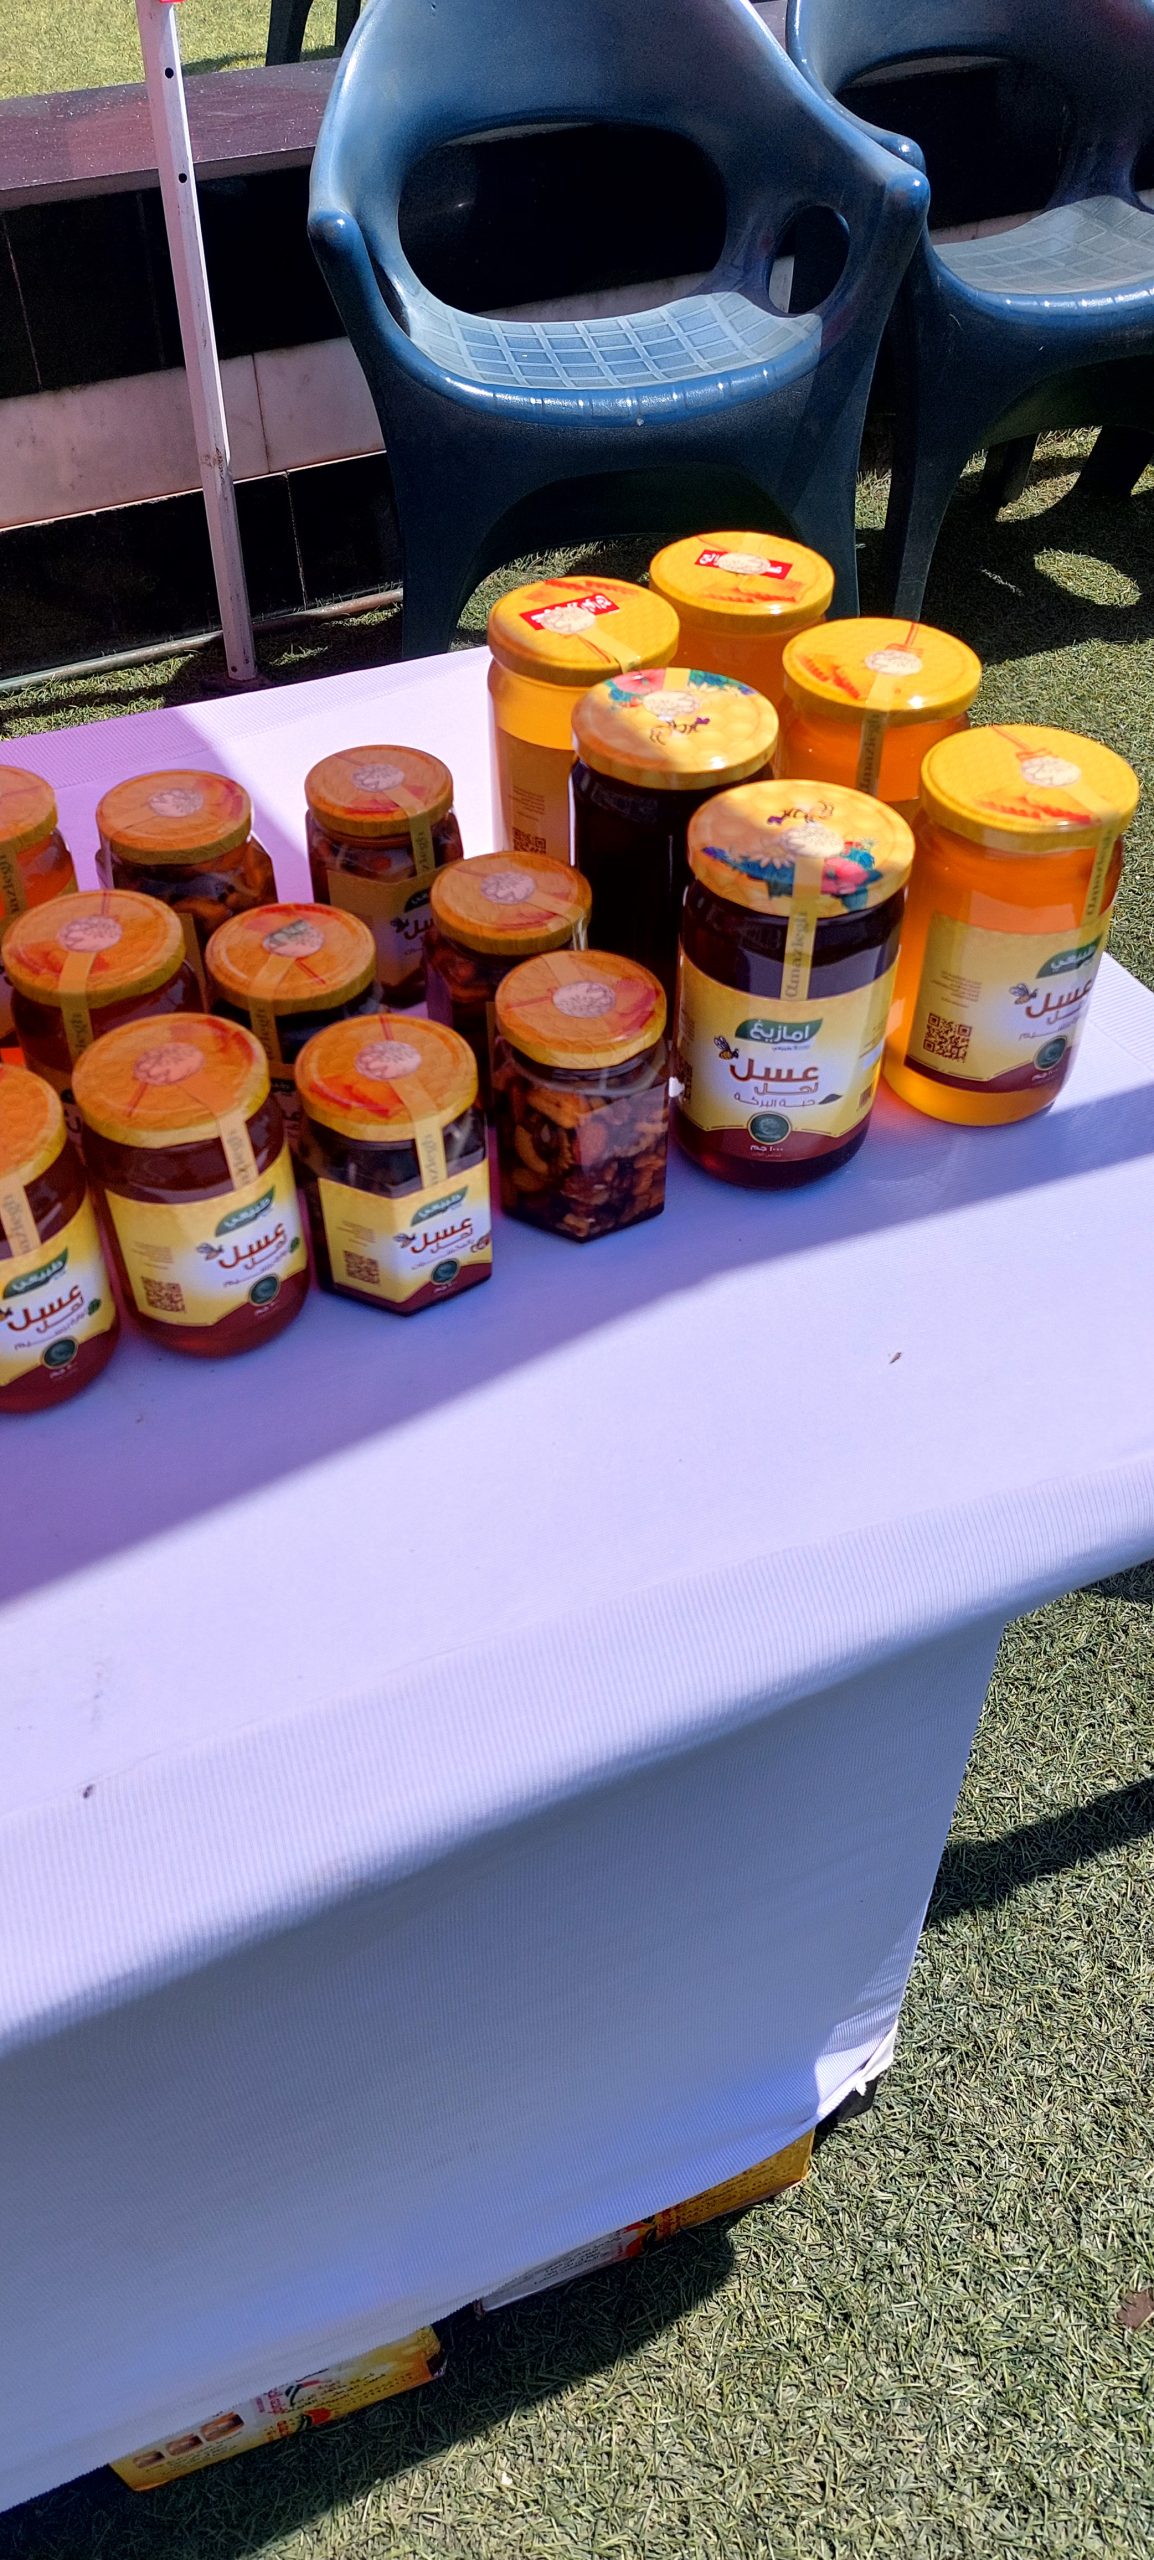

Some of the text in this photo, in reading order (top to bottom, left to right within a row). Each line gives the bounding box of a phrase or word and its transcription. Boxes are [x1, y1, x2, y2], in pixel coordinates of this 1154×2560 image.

[1026, 979, 1093, 1019] عسل
[729, 1058, 819, 1082] عسل
[218, 1222, 286, 1269] عسل
[410, 1217, 472, 1254] عسل
[7, 1283, 82, 1332] عسل
